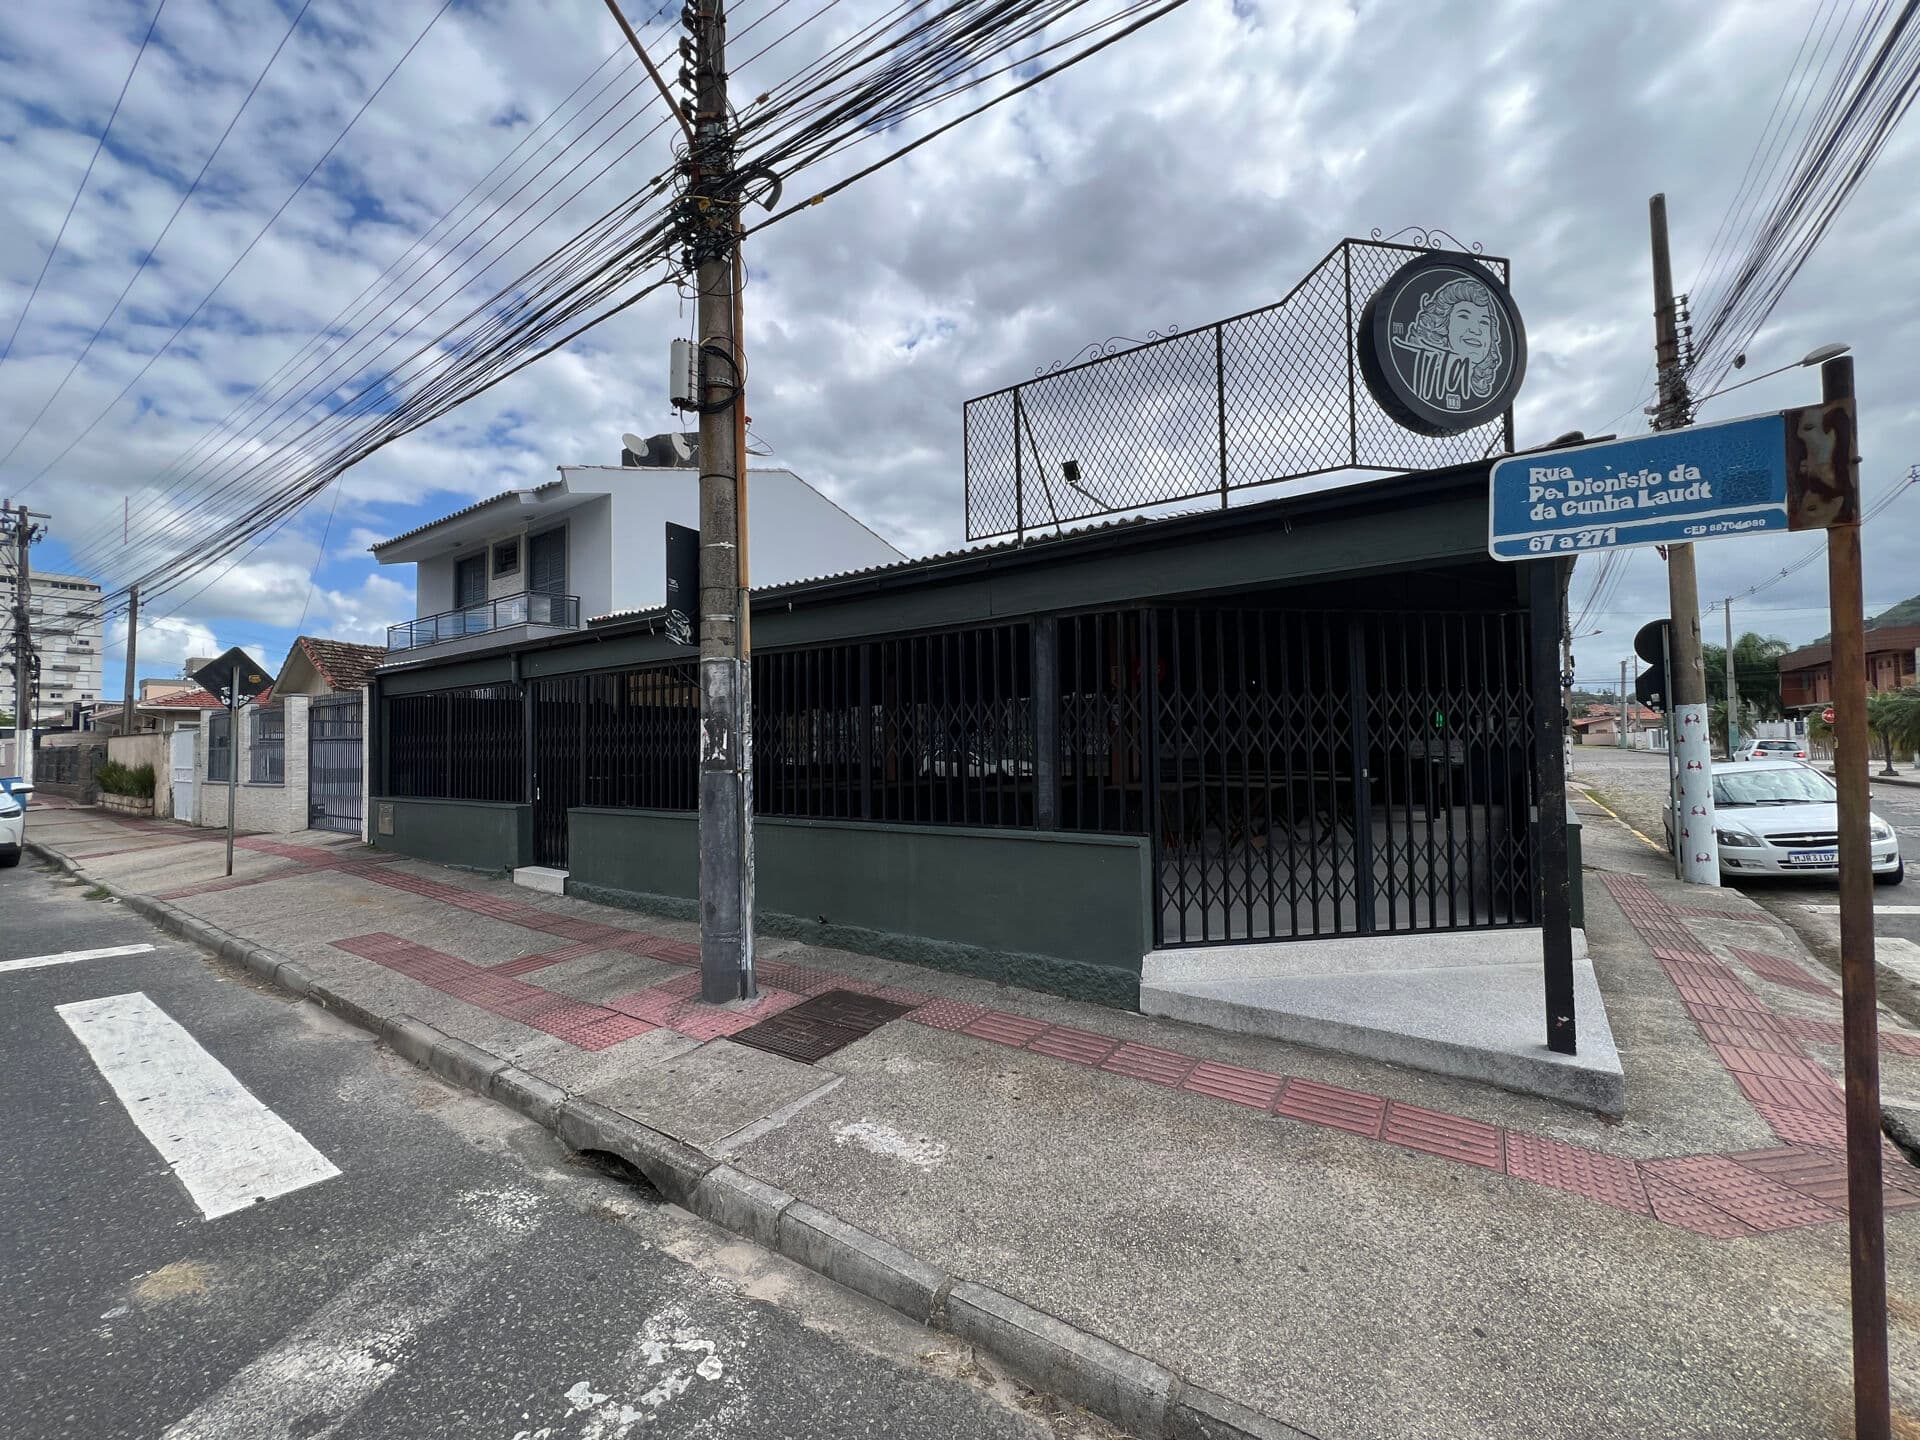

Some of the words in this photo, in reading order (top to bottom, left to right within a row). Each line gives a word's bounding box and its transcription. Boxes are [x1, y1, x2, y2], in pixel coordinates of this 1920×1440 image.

[1529, 466, 1574, 484] Rua
[1668, 464, 1701, 482] da
[1530, 502, 1557, 521] da
[1561, 494, 1634, 516] Cunha
[1638, 481, 1712, 508] Laudt
[1529, 534, 1555, 551] 67
[1559, 536, 1574, 549] a
[1576, 527, 1617, 548] 271
